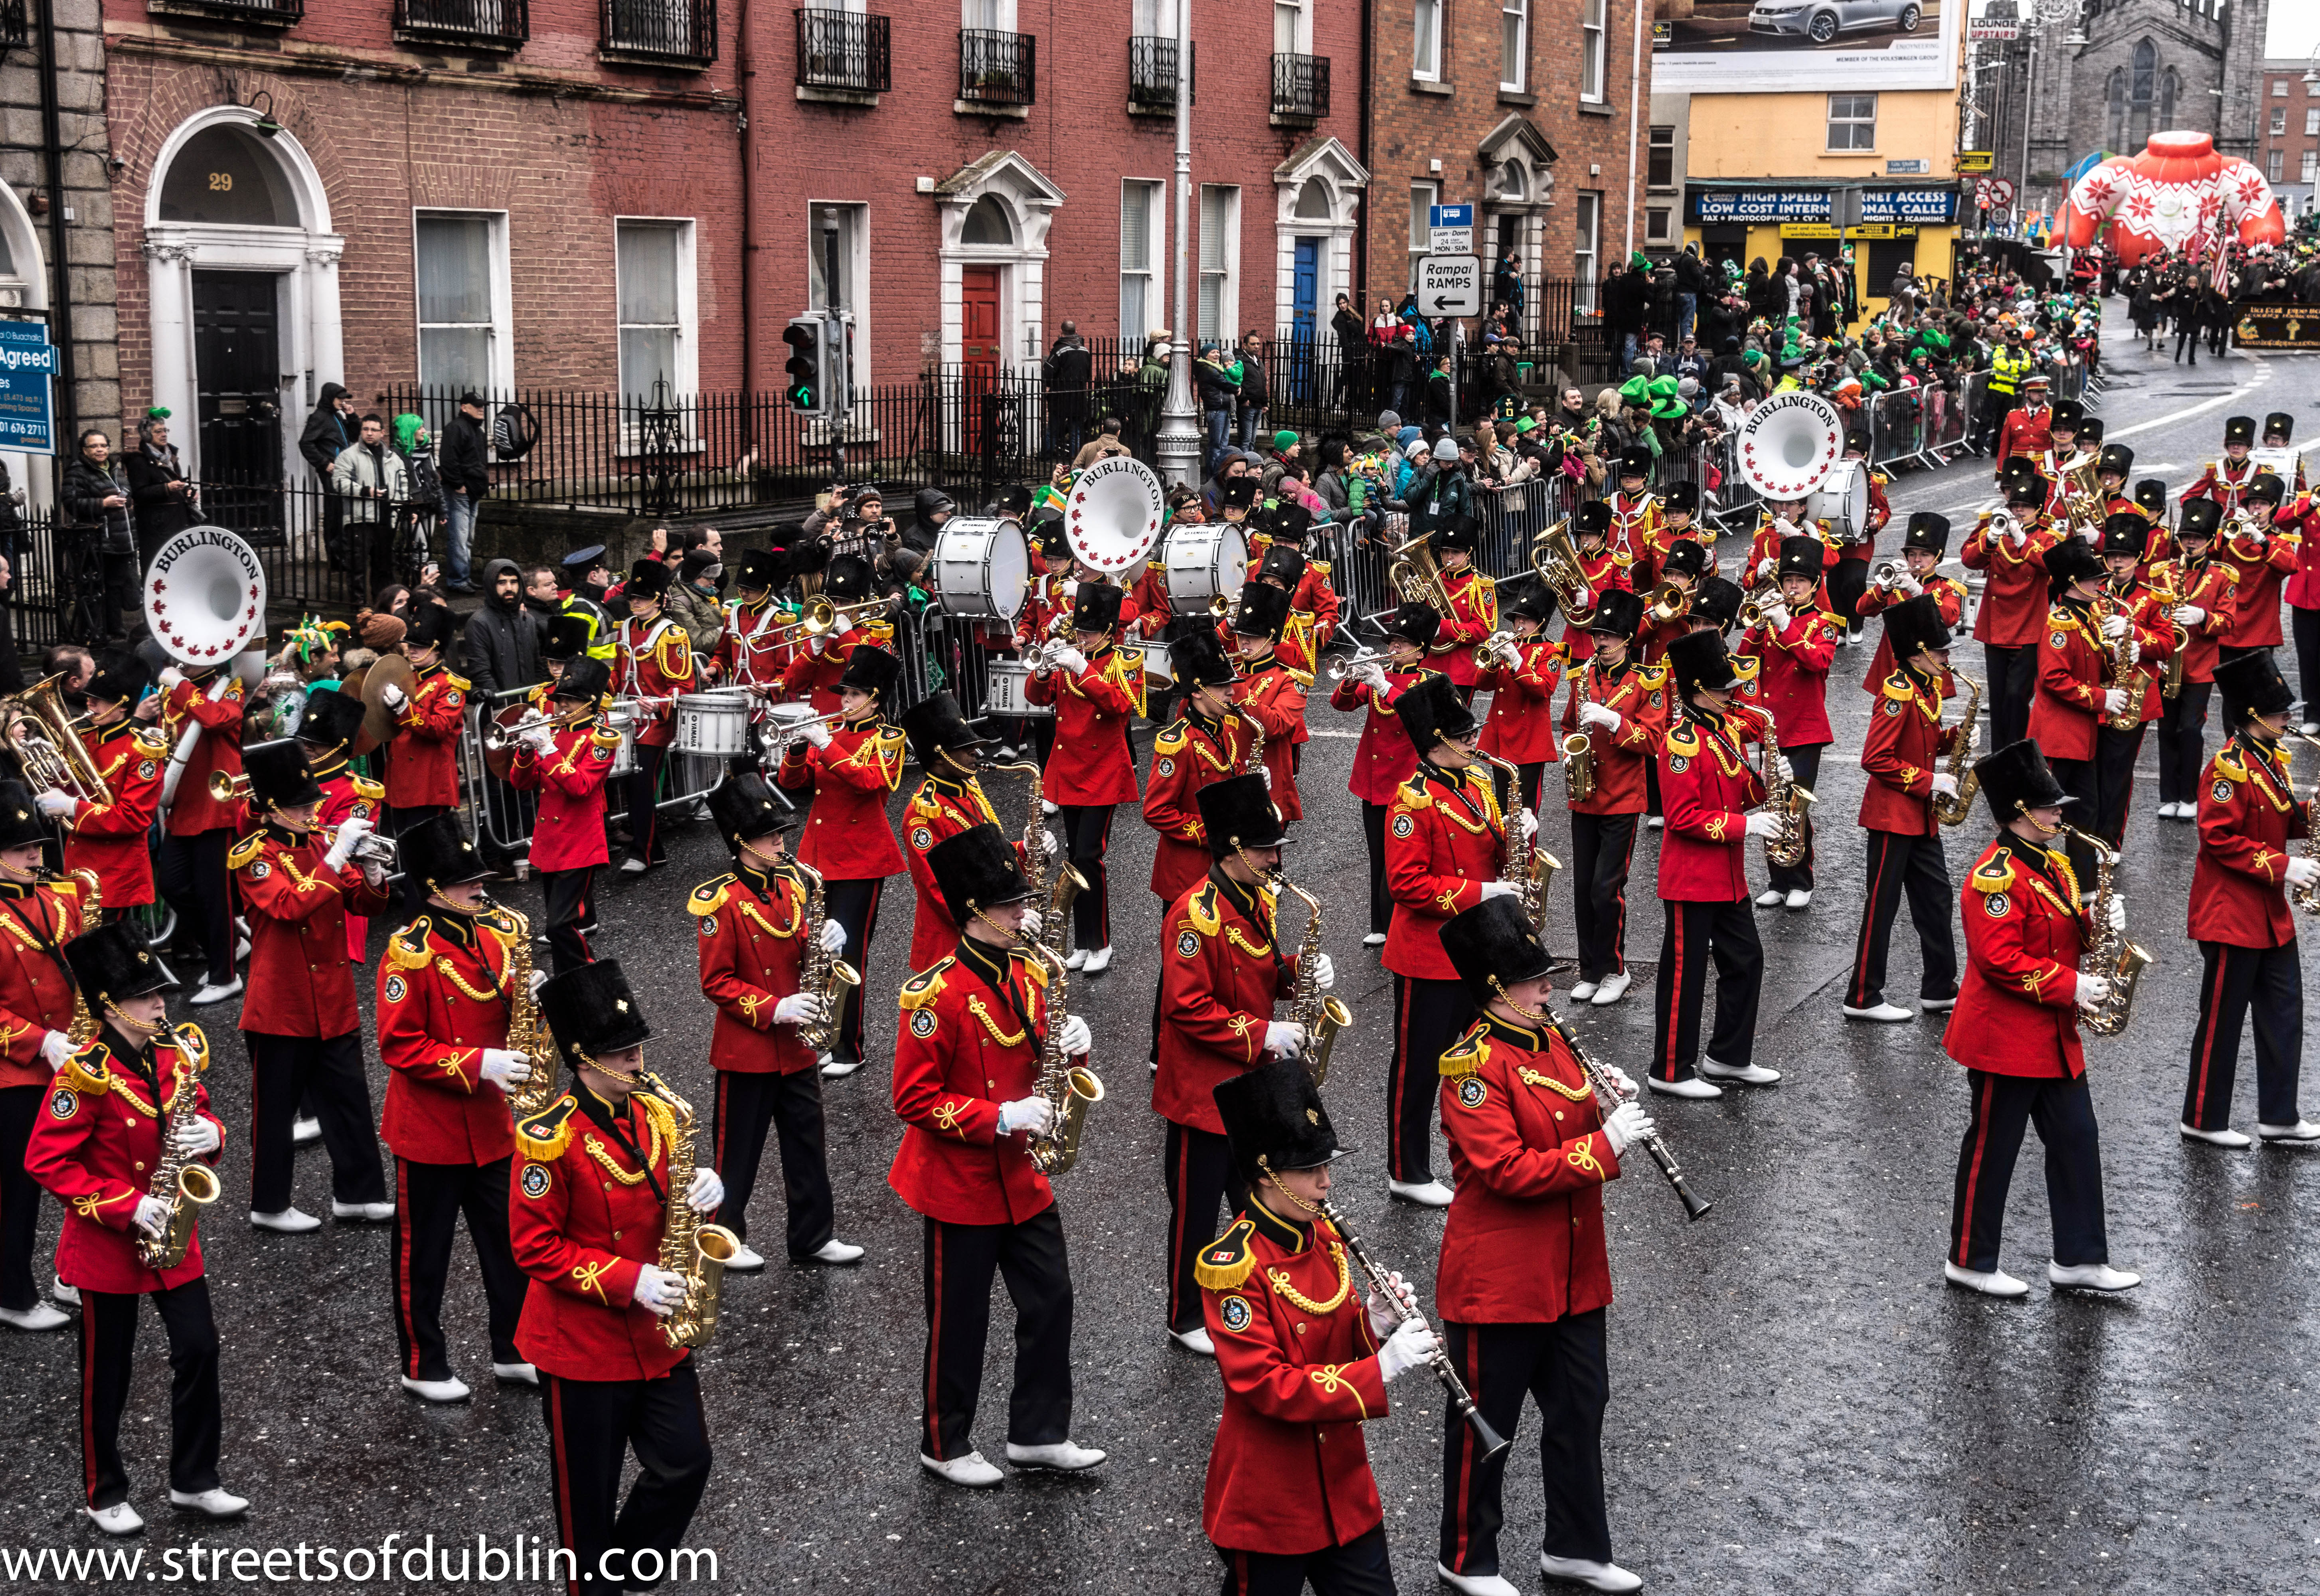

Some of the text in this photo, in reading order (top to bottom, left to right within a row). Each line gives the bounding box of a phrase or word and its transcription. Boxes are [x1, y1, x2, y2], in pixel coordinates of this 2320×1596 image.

[209, 172, 232, 191] 29
[1742, 192, 1776, 202] HIGH
[1781, 192, 1822, 202] SPEED
[1895, 192, 1947, 203] ACCESS
[1701, 203, 1735, 213] LOW
[1738, 204, 1775, 213] COST
[1901, 204, 1947, 214] CALLS
[1996, 210, 2006, 220] 50
[1426, 263, 1474, 276] Rampaí
[1427, 278, 1471, 289] RAMPS
[0, 346, 51, 370] Agreed
[1745, 395, 1836, 436] BURLINGTON
[11, 423, 26, 434] 676
[27, 424, 46, 436] 2711
[1083, 461, 1160, 511] BURLINGTON
[155, 531, 259, 580] BURLINGTON
